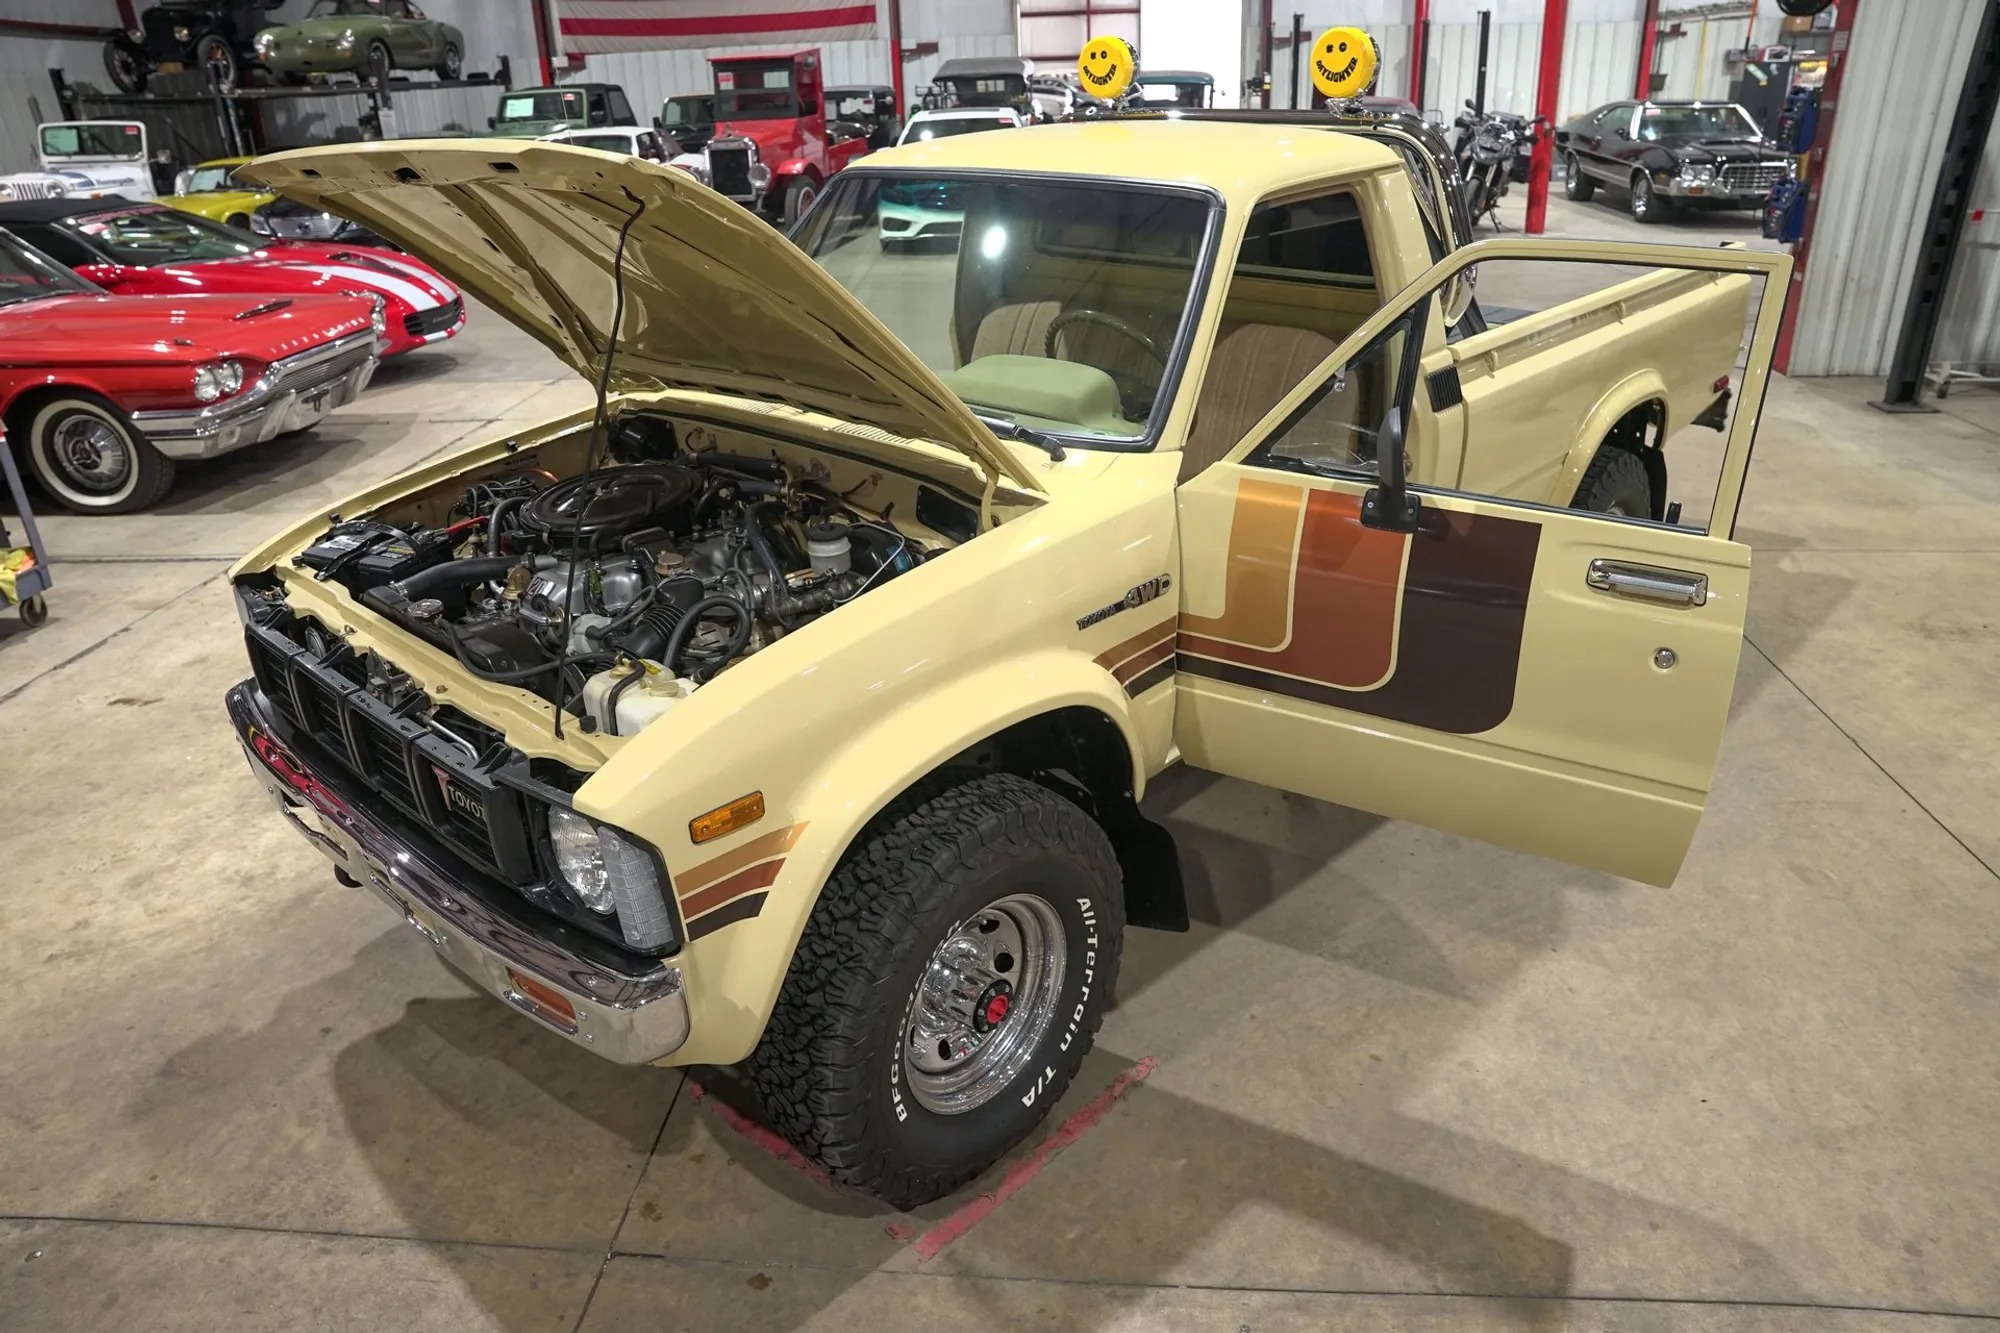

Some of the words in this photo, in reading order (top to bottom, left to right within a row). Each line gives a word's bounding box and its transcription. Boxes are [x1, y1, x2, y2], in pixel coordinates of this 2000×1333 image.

[1083, 63, 1117, 86] DAYLIGHTER
[1316, 57, 1358, 83] DAYLIGHTER
[1077, 605, 1117, 631] TOYOTA
[1124, 573, 1173, 608] 4WD
[447, 785, 485, 819] TOYOT
[1060, 897, 1099, 1052] All-Terrain
[1020, 1065, 1057, 1109] T/A
